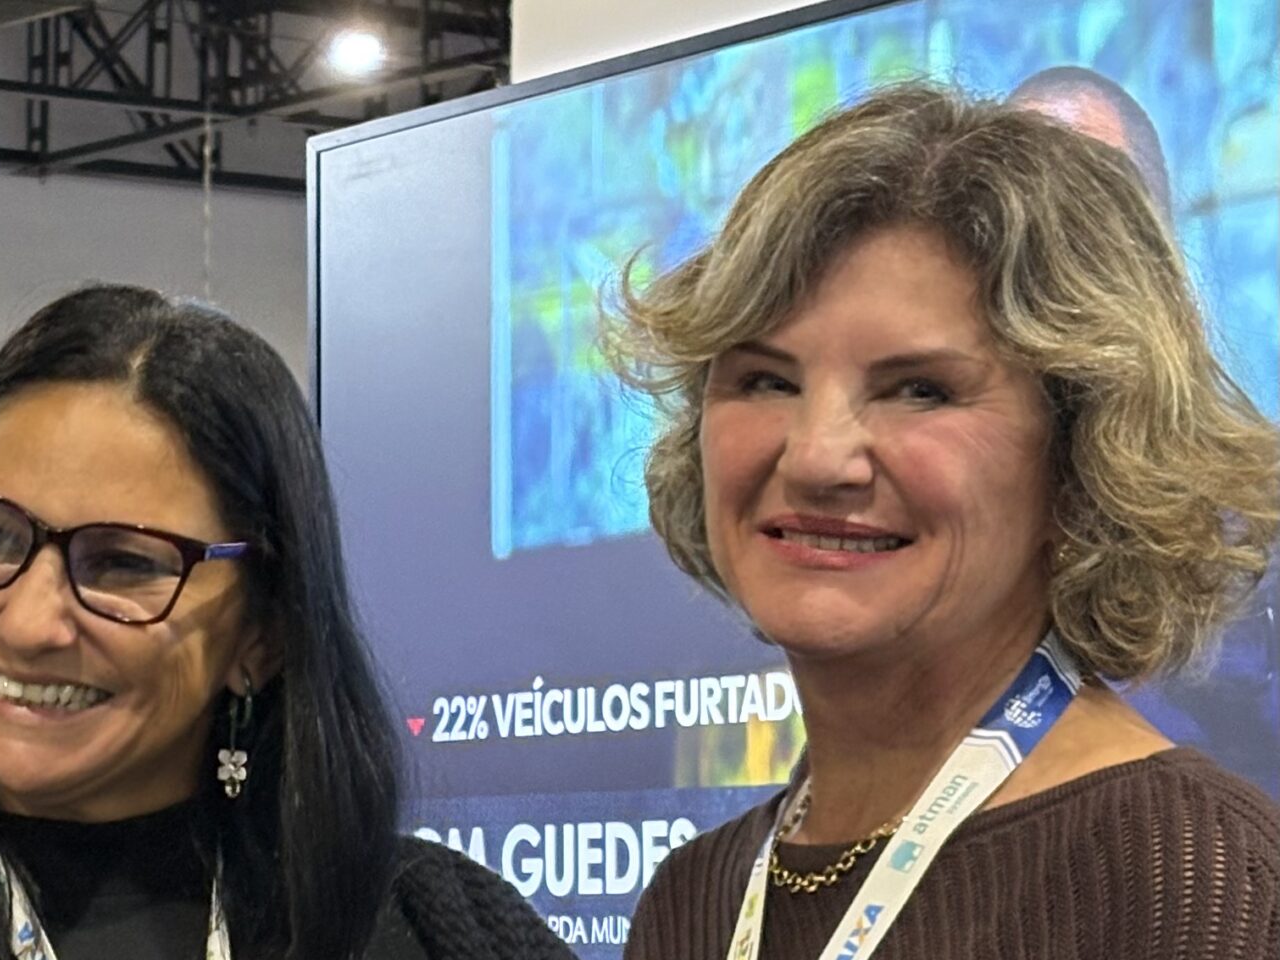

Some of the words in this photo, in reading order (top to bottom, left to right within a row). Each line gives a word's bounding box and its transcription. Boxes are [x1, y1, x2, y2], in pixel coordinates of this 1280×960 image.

[432, 695, 489, 742] 22%
[492, 676, 650, 738] VEÍCULOS
[654, 671, 803, 728] FURTAD
[913, 774, 968, 834] atman
